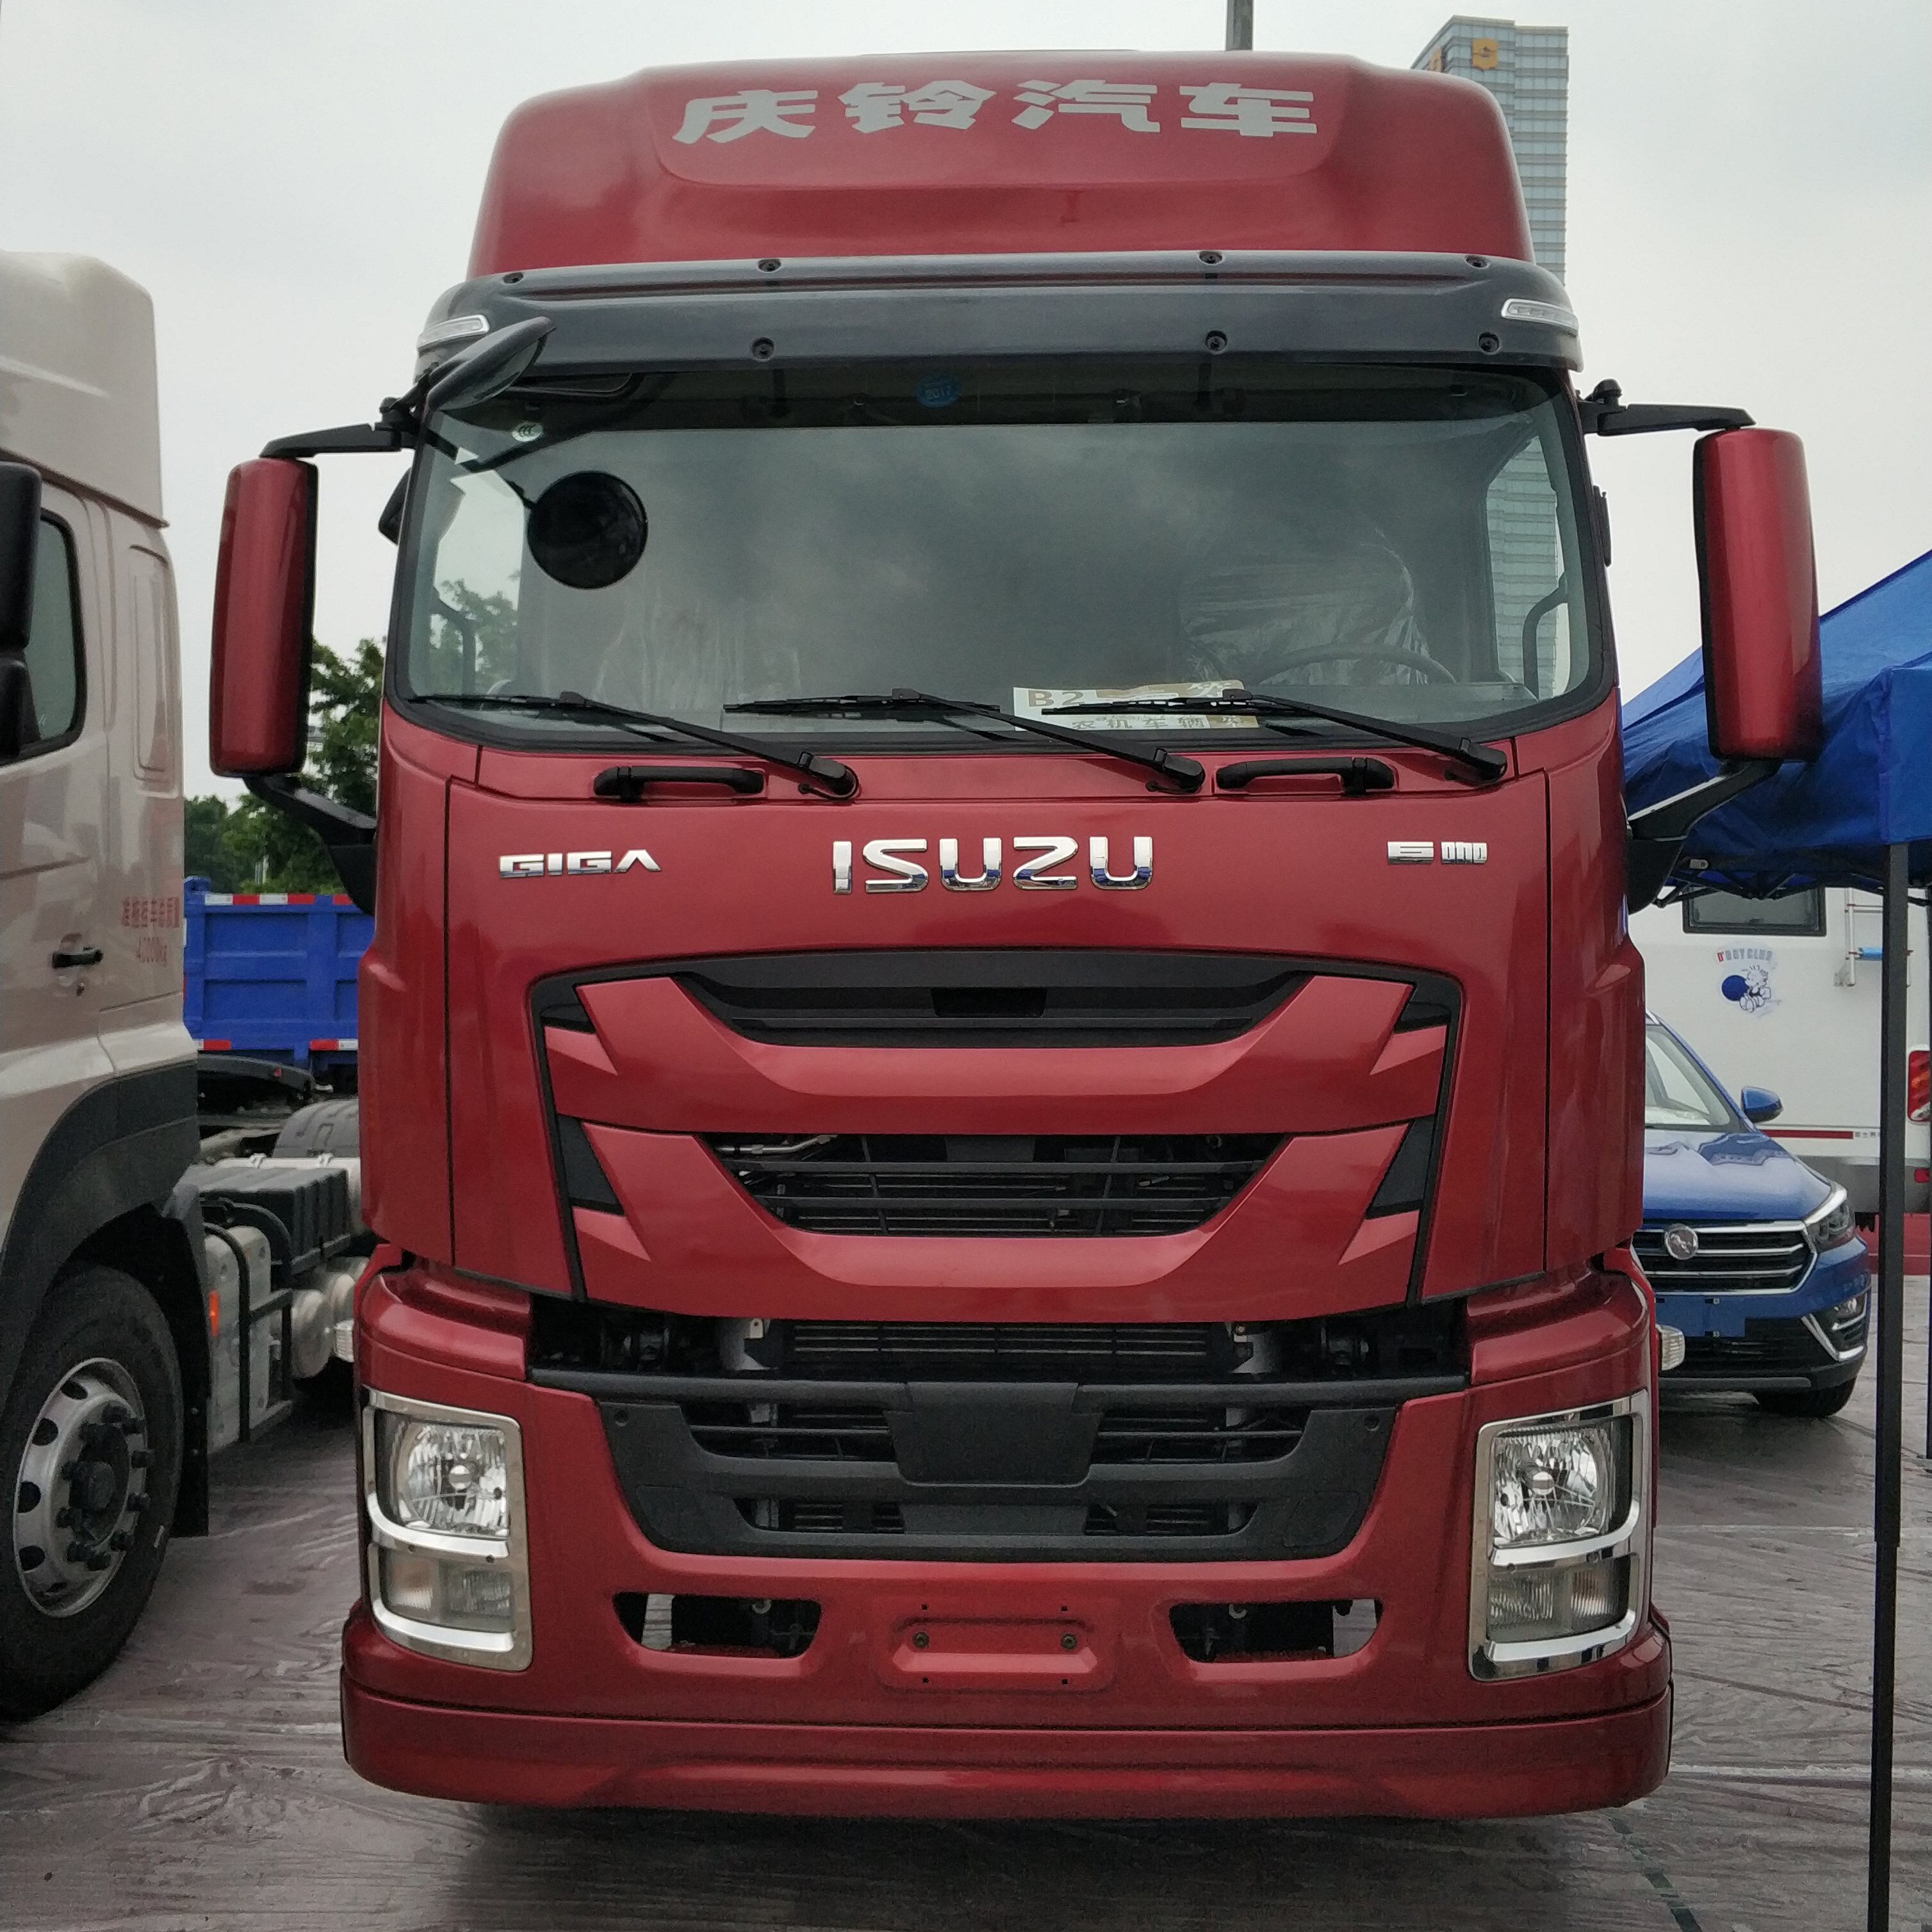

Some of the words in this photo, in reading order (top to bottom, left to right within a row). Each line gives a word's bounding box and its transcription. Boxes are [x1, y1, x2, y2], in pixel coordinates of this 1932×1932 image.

[672, 79, 1318, 145] 庆铃汽车
[1028, 689, 1085, 707] B2
[500, 849, 661, 878] GIGA
[832, 836, 1153, 894] ISUZU
